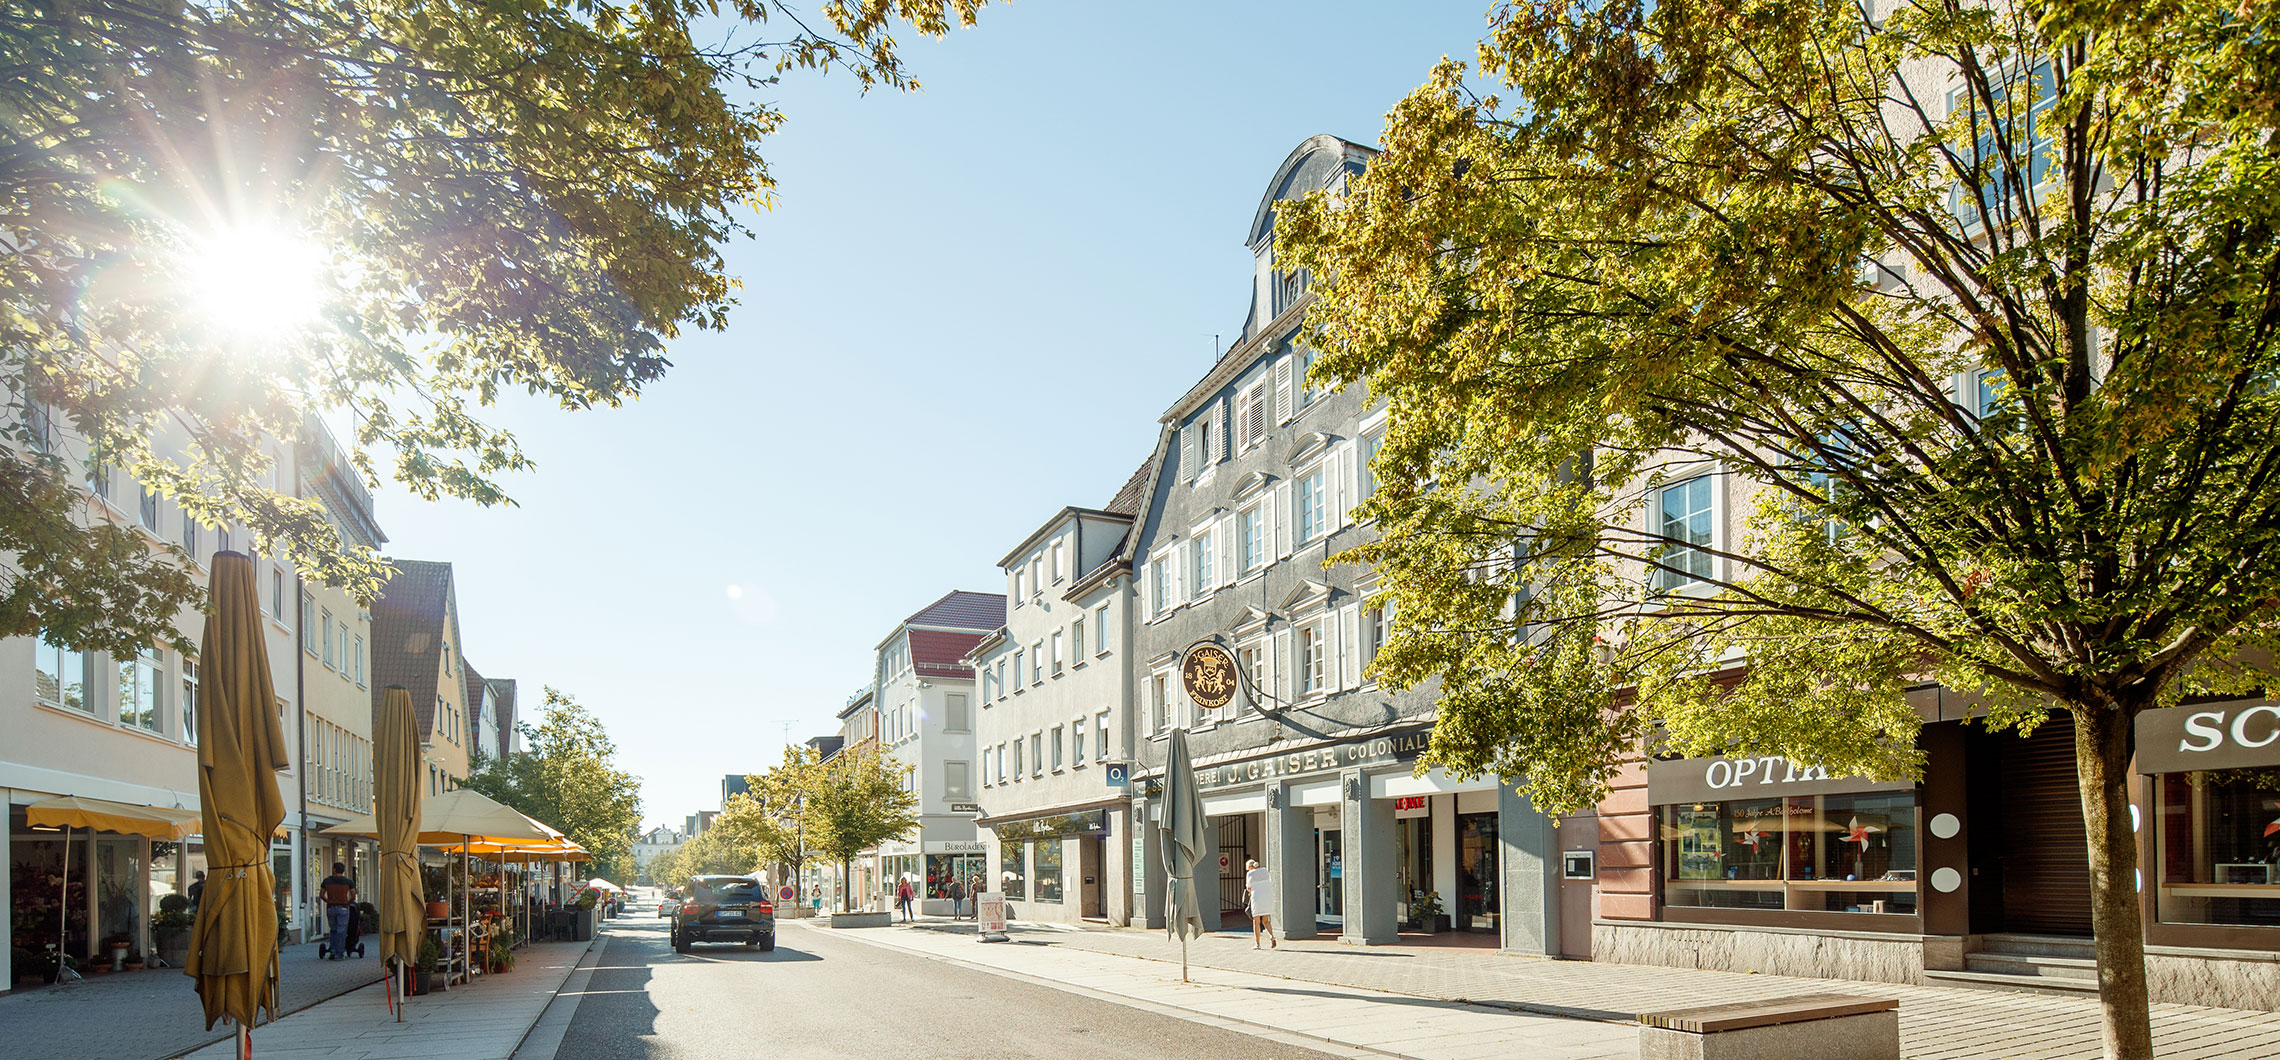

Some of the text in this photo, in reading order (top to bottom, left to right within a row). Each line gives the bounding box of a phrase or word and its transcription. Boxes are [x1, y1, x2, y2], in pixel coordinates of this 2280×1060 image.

[1189, 689, 1228, 707] FEINKOST
[1195, 771, 1221, 785] DEREI
[1246, 747, 1338, 781] GAISER
[1734, 808, 1745, 818] 150
